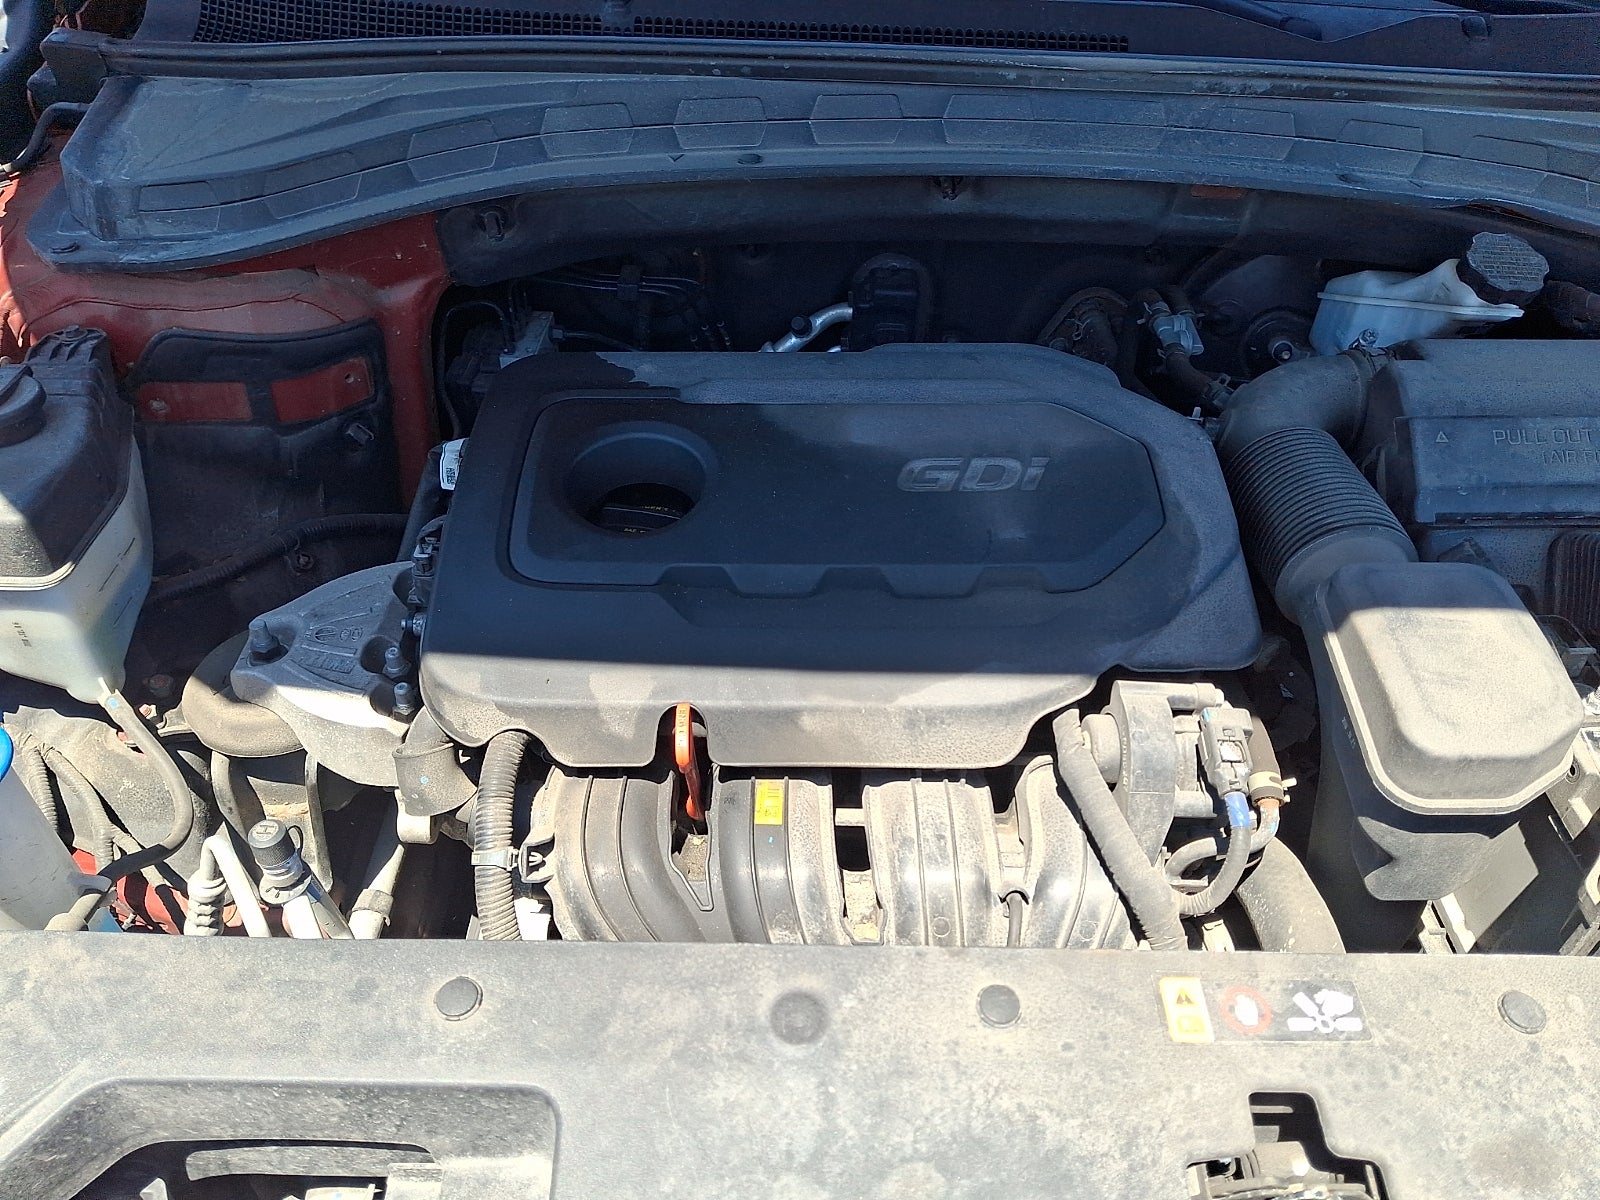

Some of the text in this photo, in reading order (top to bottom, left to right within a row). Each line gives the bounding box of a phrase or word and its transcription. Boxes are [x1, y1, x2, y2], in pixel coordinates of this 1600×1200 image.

[1492, 429, 1593, 446] PULL OUT
[1582, 449, 1600, 464] FI
